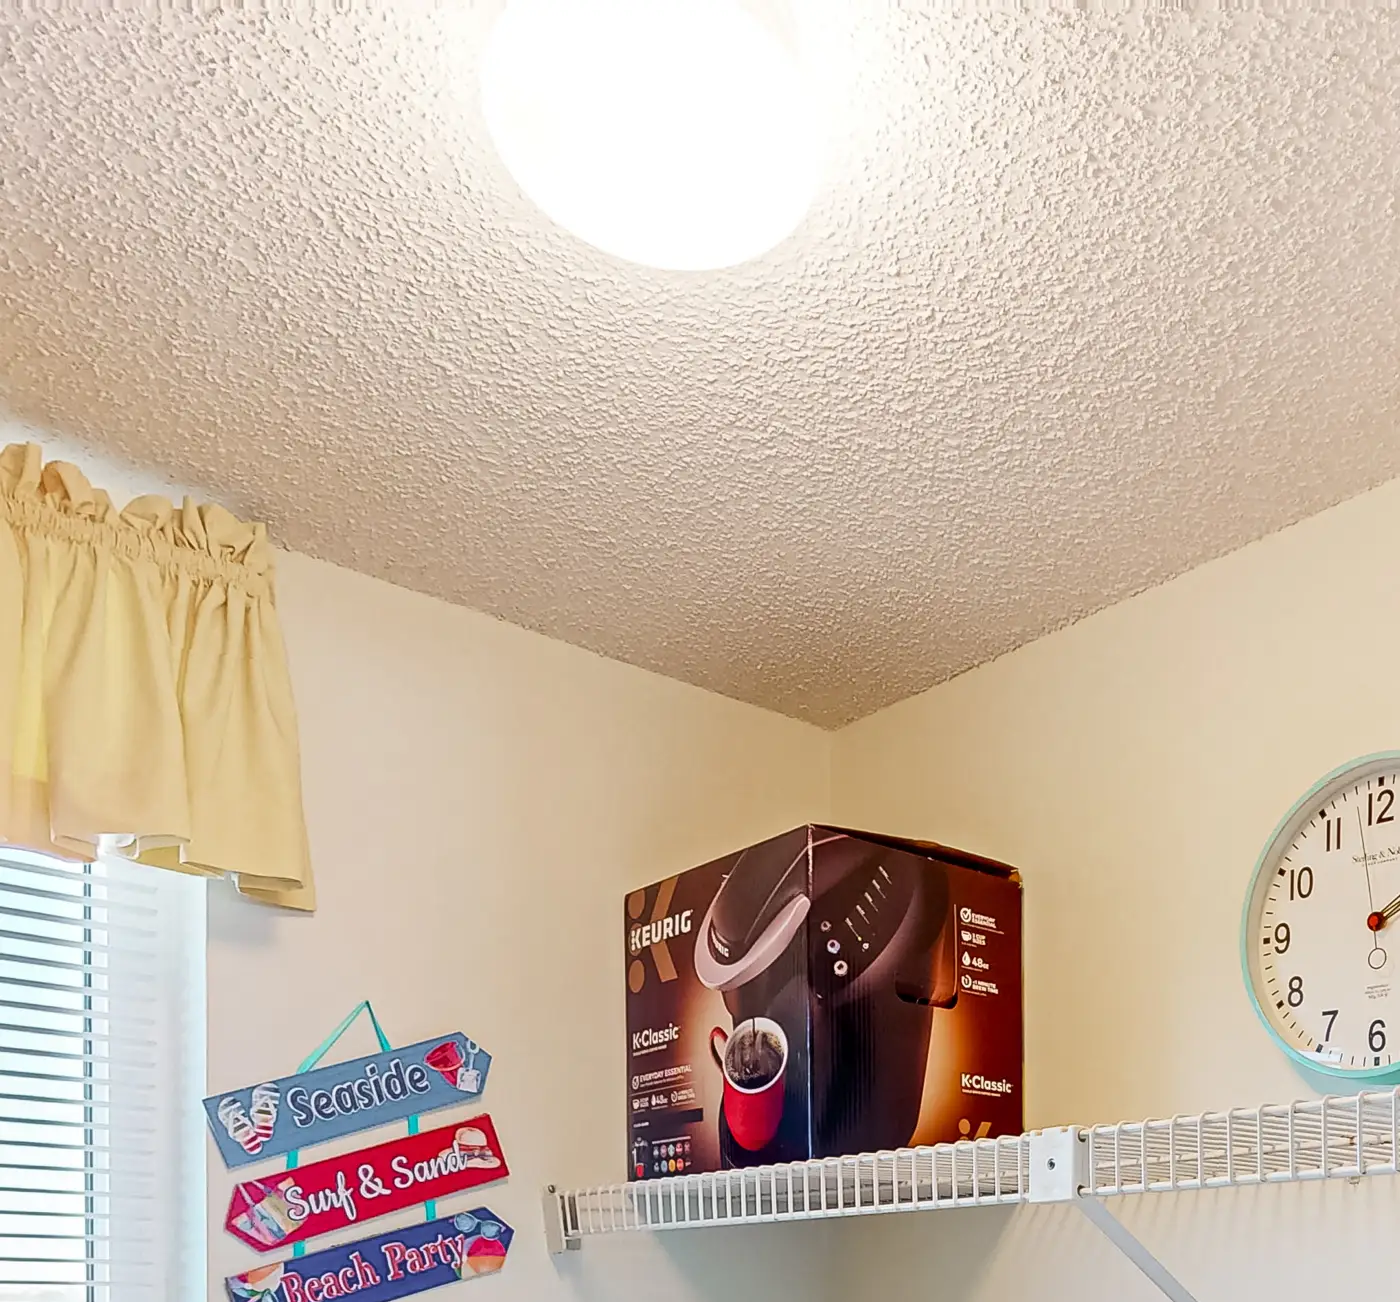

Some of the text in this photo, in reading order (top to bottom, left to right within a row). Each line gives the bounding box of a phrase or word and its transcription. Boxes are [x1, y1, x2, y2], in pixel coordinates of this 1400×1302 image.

[1367, 788, 1395, 827] 12
[1325, 816, 1342, 853] 11
[1289, 865, 1314, 901] 10
[631, 909, 692, 951] KEURIG
[1273, 922, 1291, 955] 9
[1287, 975, 1305, 1008] 8
[1321, 1009, 1340, 1043] 7
[1367, 1018, 1387, 1053] 6
[287, 1058, 431, 1127] Seaside
[285, 1140, 468, 1221] Surf & Sand
[382, 1233, 466, 1281] Party
